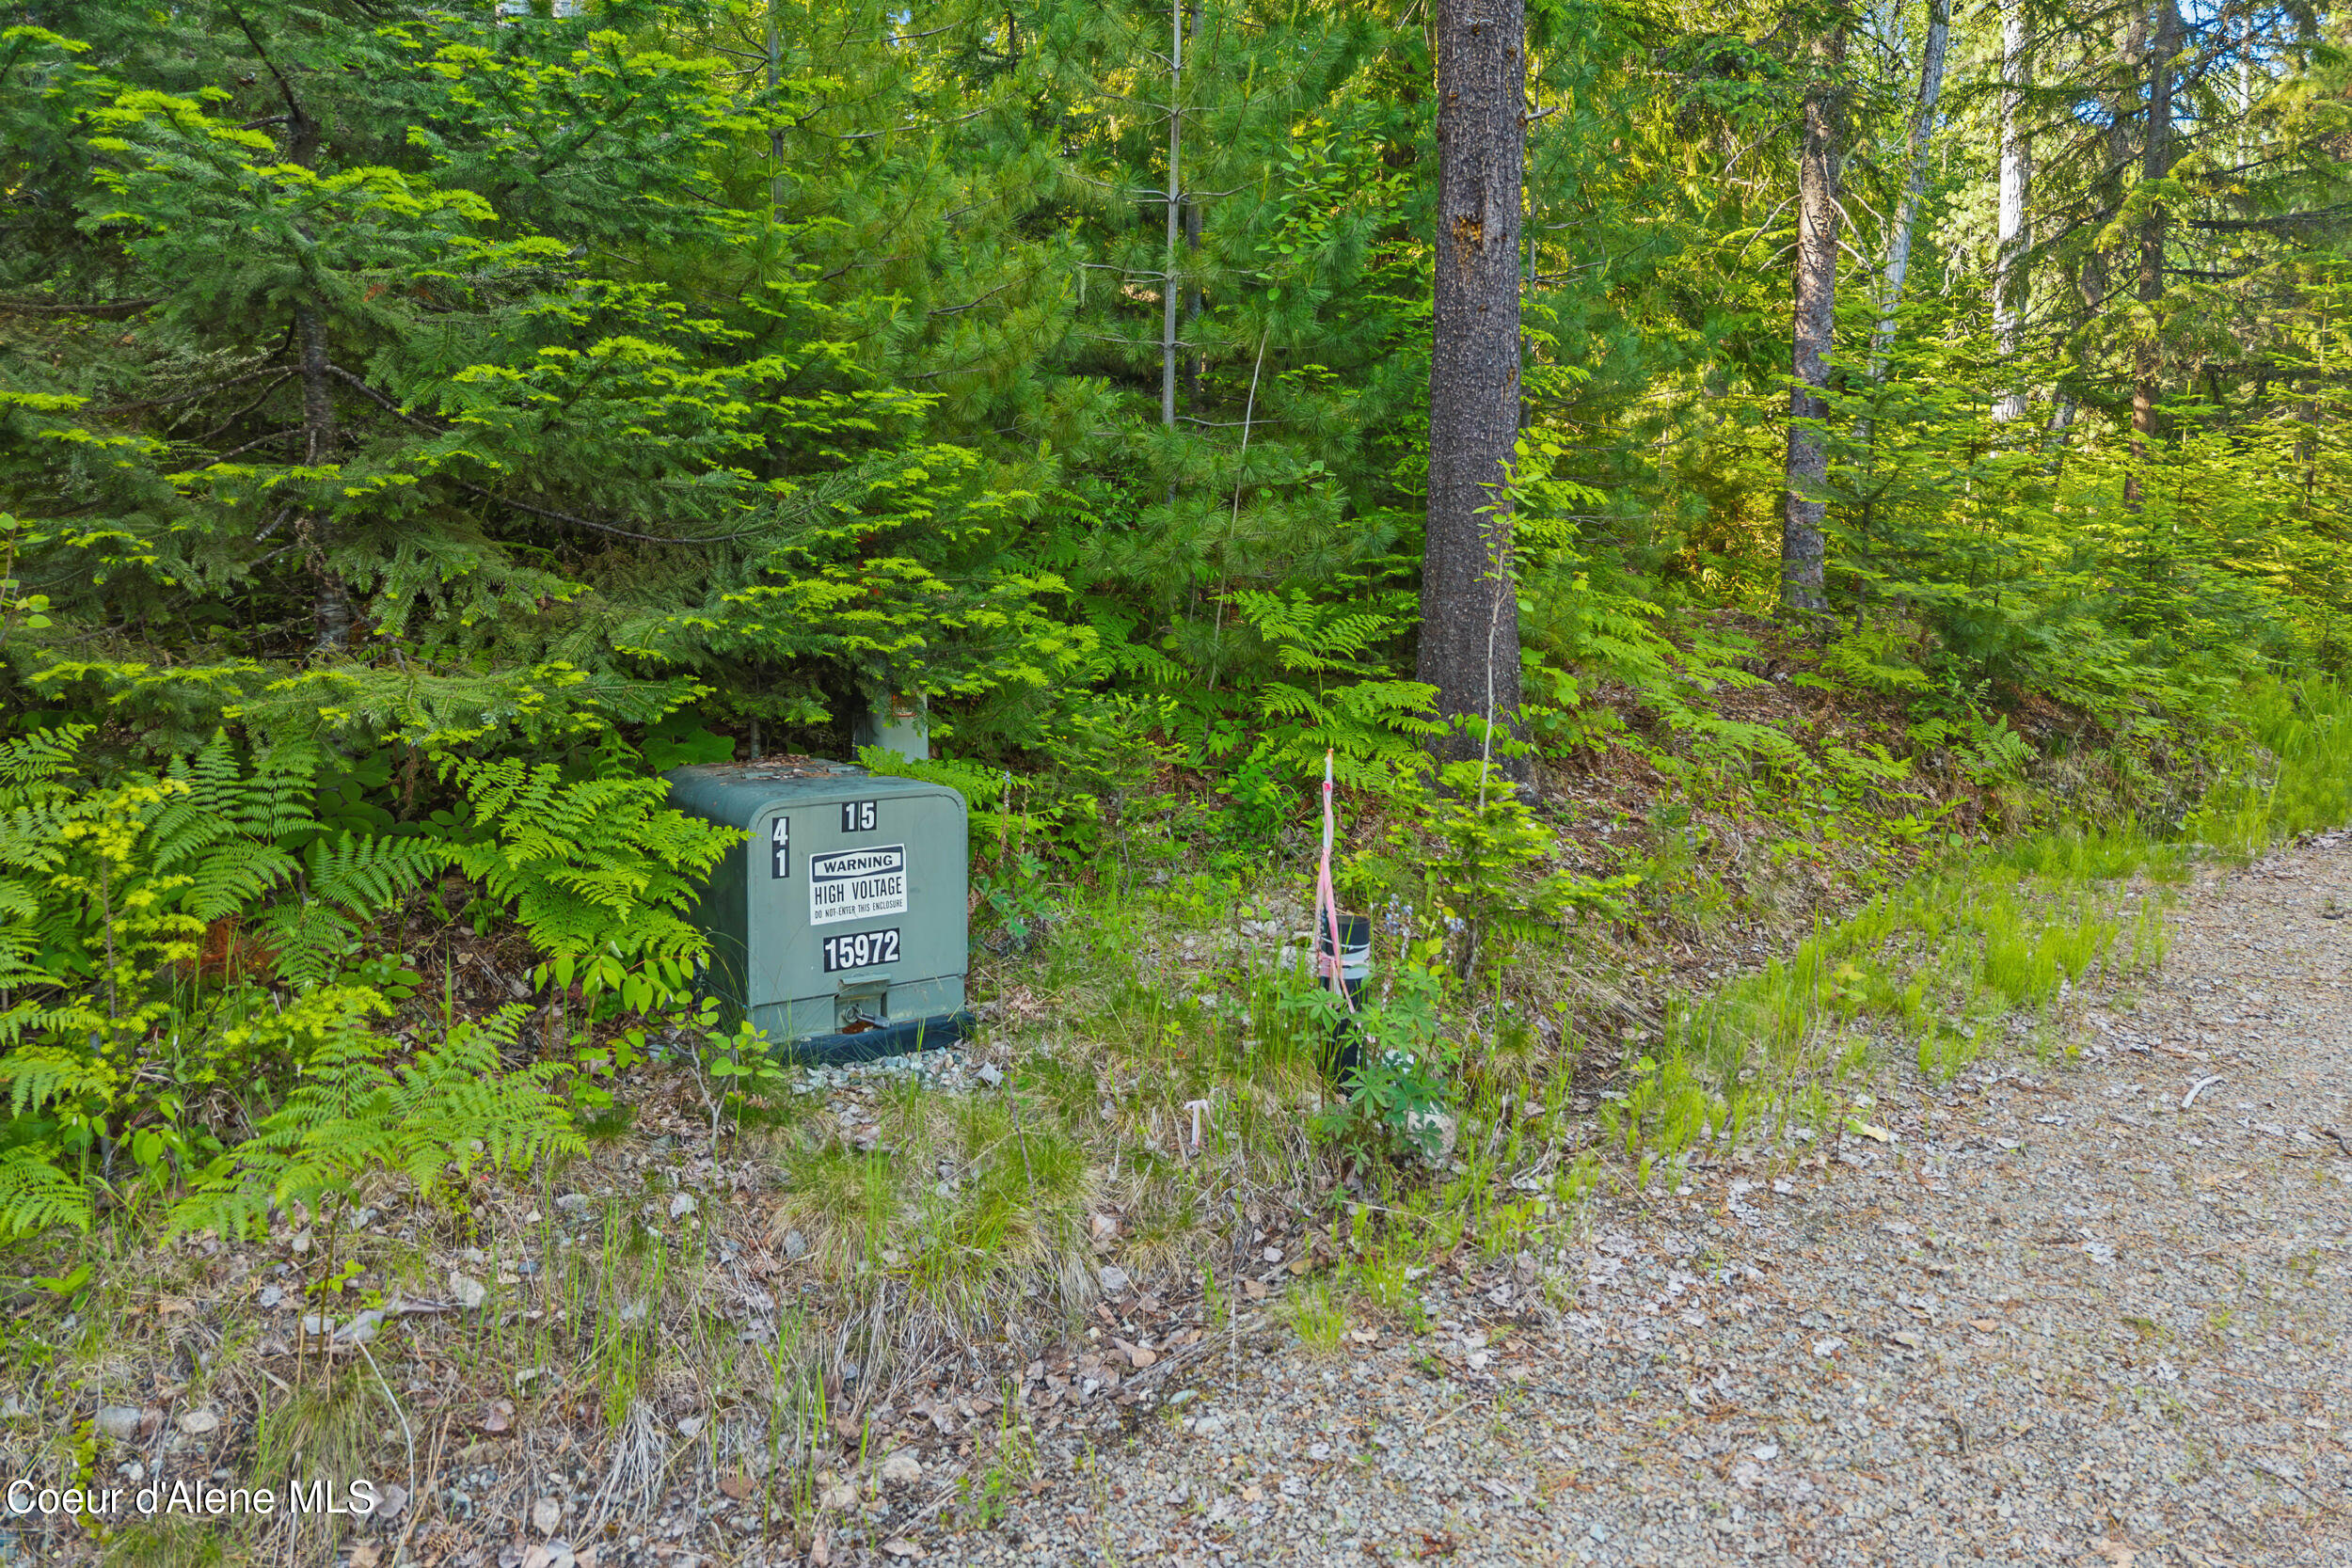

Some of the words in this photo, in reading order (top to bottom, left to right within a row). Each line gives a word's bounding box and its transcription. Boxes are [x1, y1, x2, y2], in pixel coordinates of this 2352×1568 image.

[845, 801, 876, 831] 15
[823, 855, 893, 874] WARNING
[815, 883, 844, 906] HIGH
[851, 876, 902, 900] VOLTAGE
[815, 910, 822, 919] DO
[825, 908, 836, 918] NOT
[838, 906, 856, 916] ENTER
[858, 904, 870, 913] THIS
[872, 898, 903, 911] ENCLOSURE
[824, 930, 899, 970] 15972
